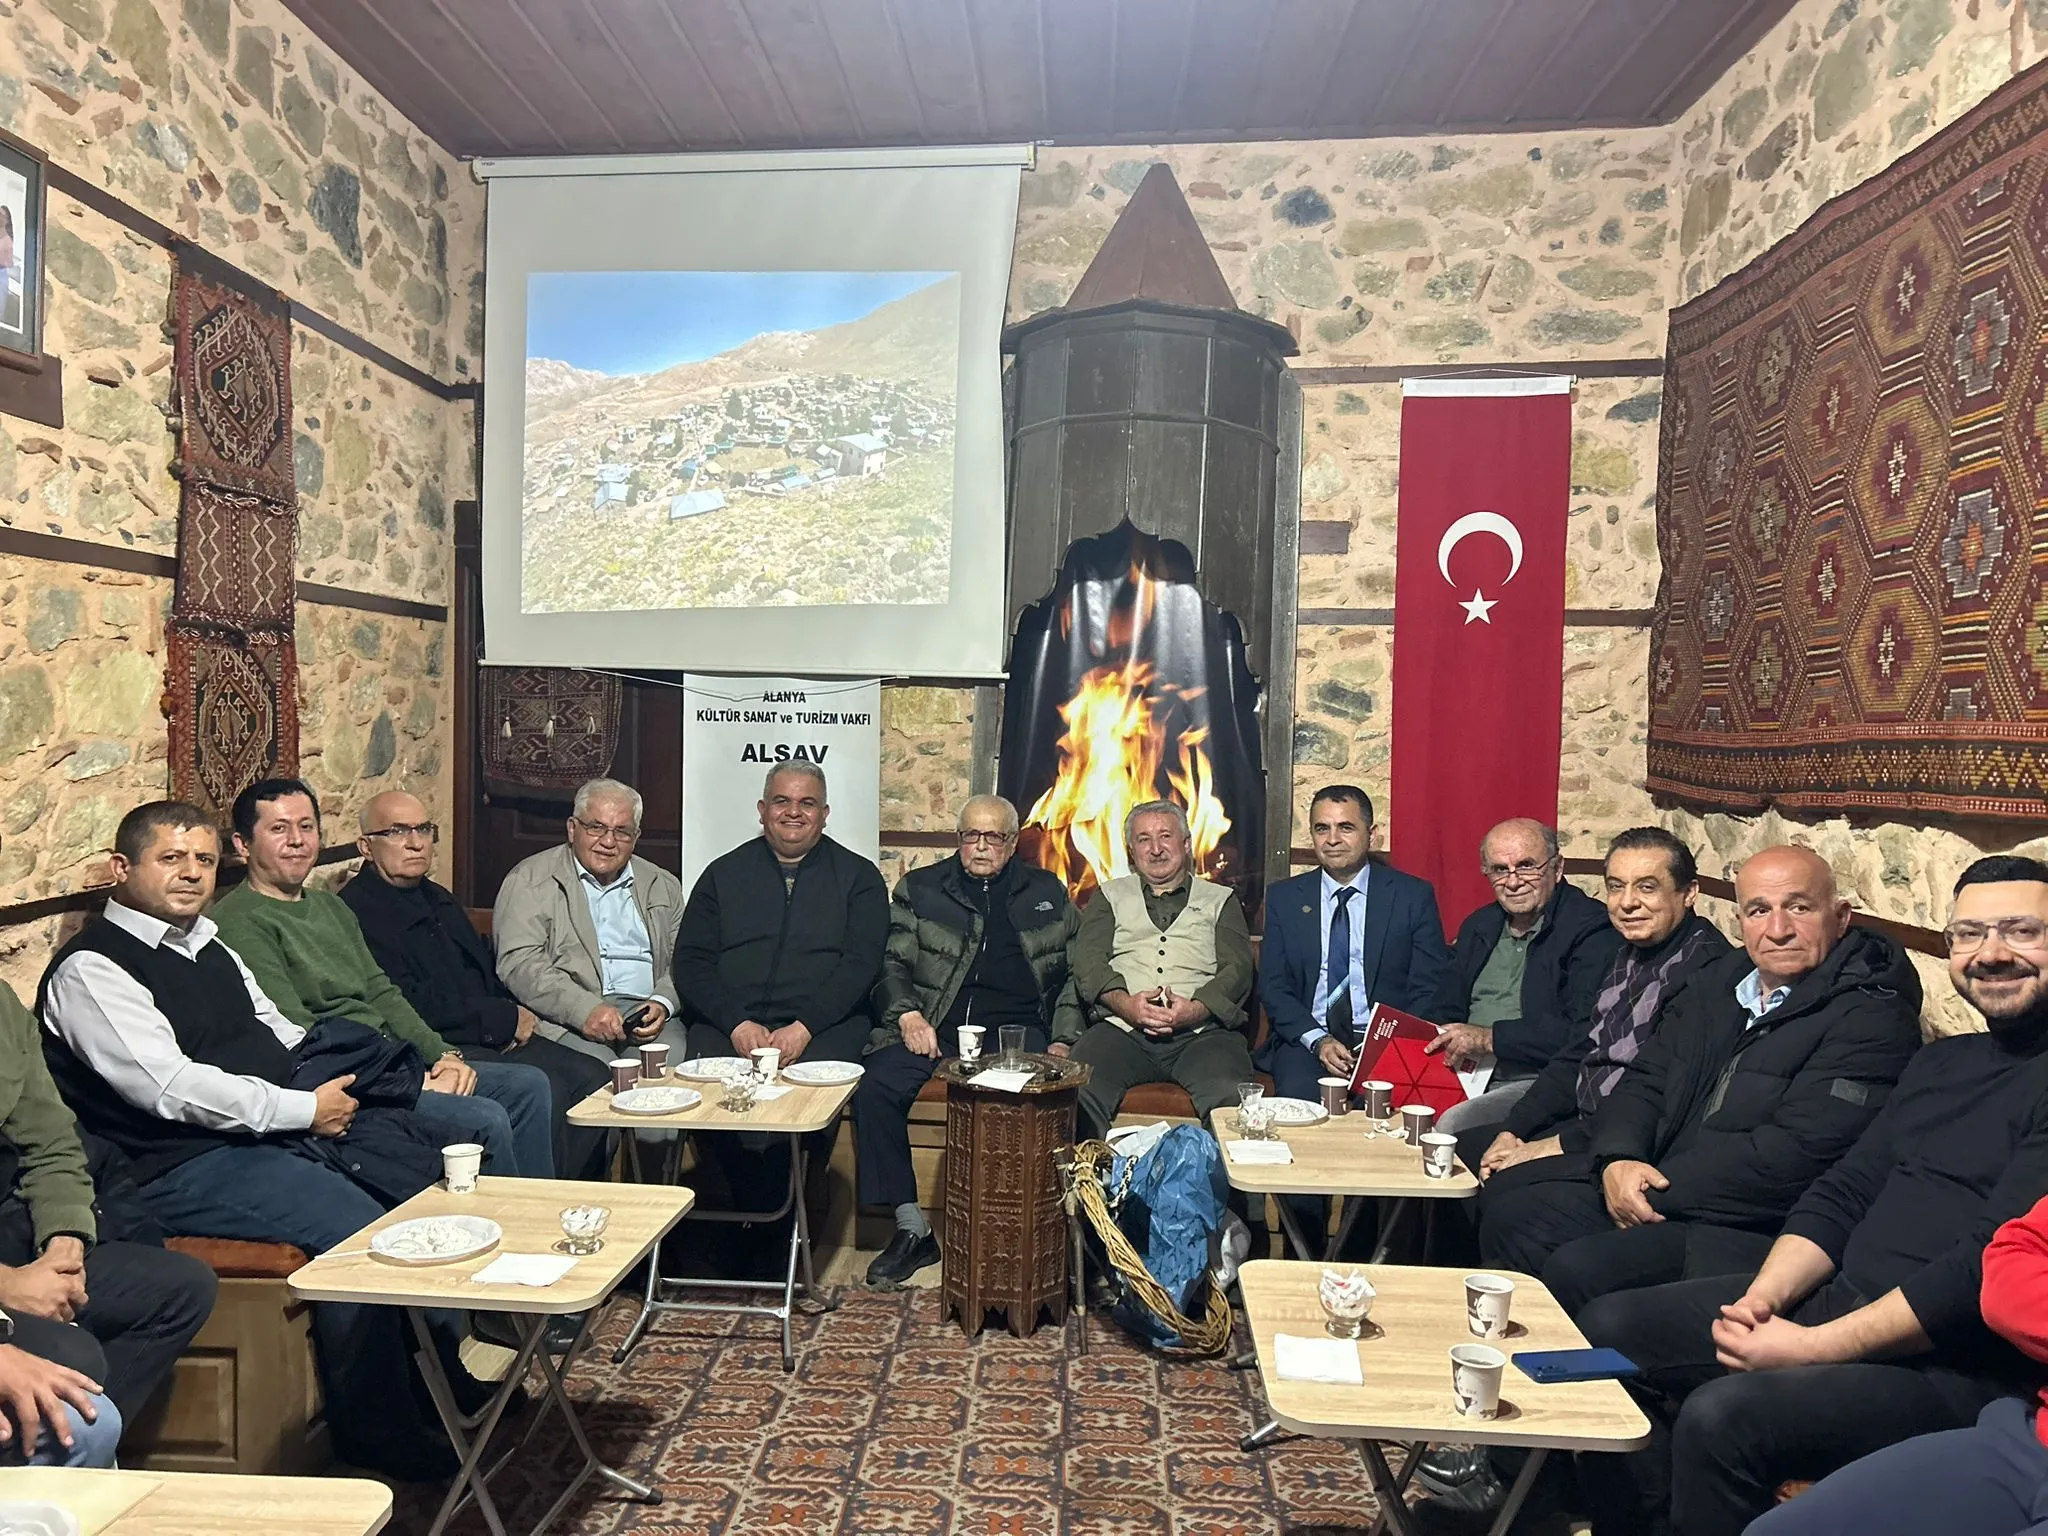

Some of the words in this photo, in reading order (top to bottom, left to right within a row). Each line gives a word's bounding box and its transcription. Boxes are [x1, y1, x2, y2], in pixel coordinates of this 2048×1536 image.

[762, 691, 806, 703] ALANYA
[697, 708, 741, 722] KÜLTÜR
[743, 711, 777, 723] SANAT
[780, 714, 793, 724] ve
[795, 710, 838, 725] TURİZM
[841, 713, 871, 725] VAKFI
[740, 743, 829, 764] ALSAV
